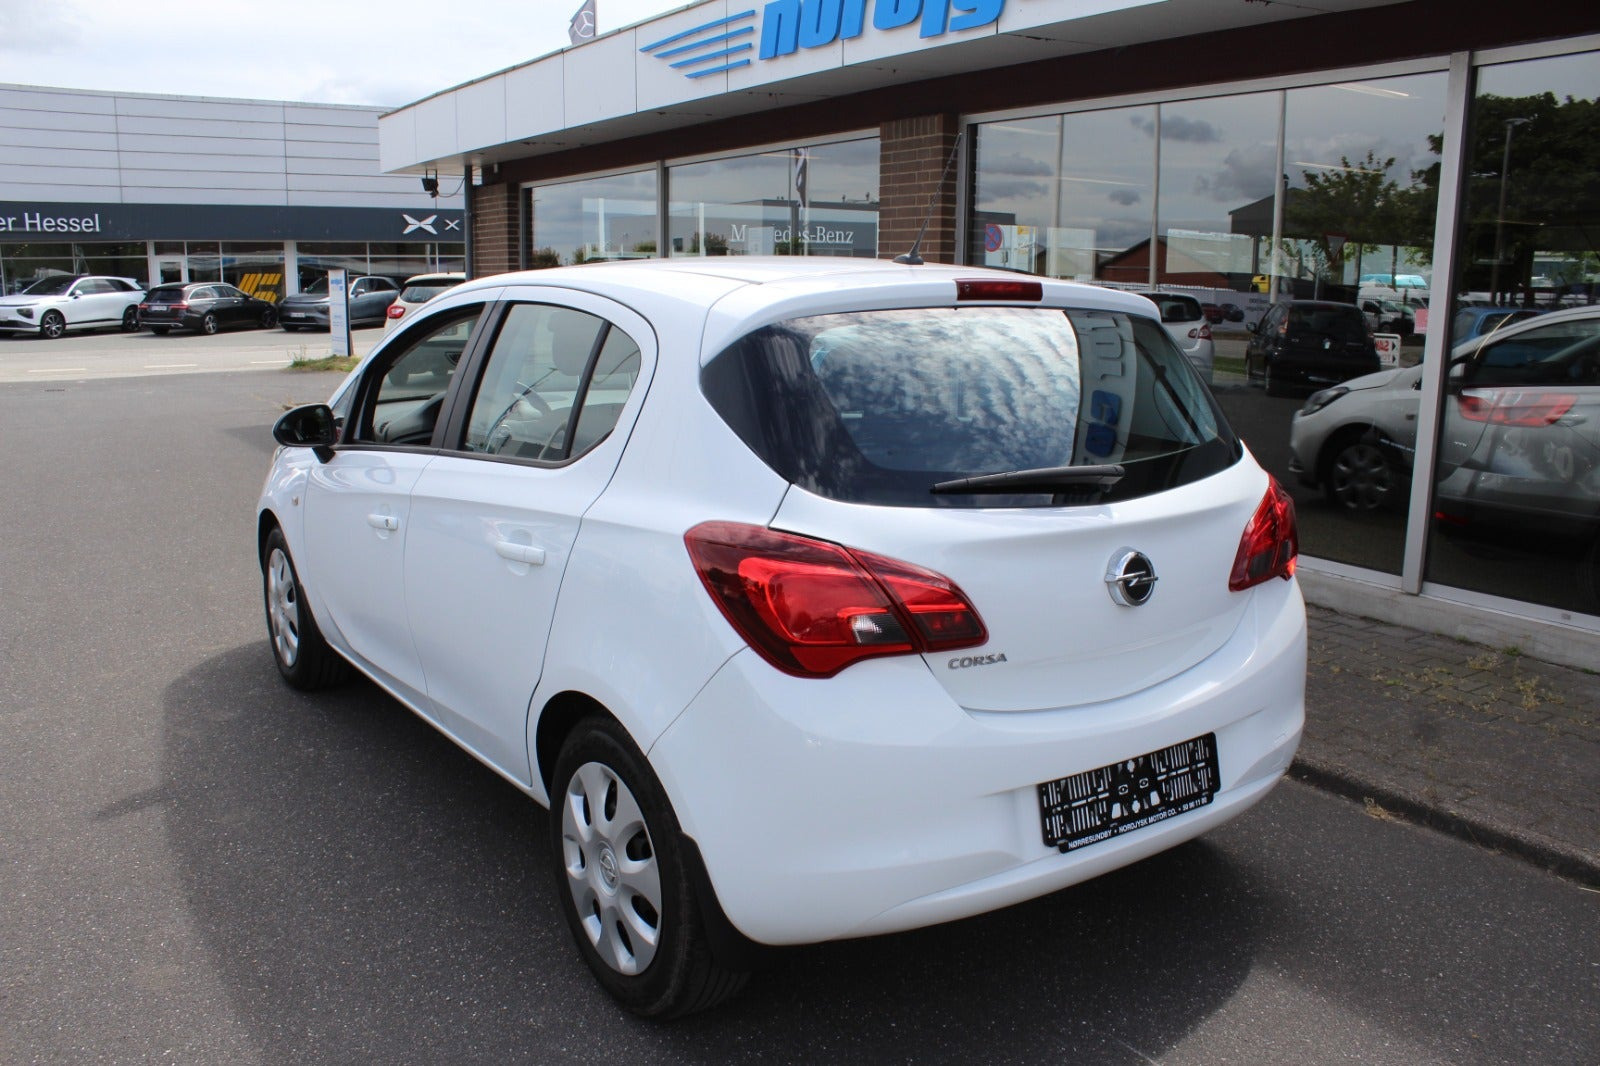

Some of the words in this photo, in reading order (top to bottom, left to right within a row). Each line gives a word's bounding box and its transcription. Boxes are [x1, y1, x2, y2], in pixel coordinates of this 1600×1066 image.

[24, 212, 100, 233] Hessel
[947, 653, 1008, 670] CORSA
[1118, 818, 1149, 834] NORDJYSK
[1148, 811, 1168, 824] MOTOR
